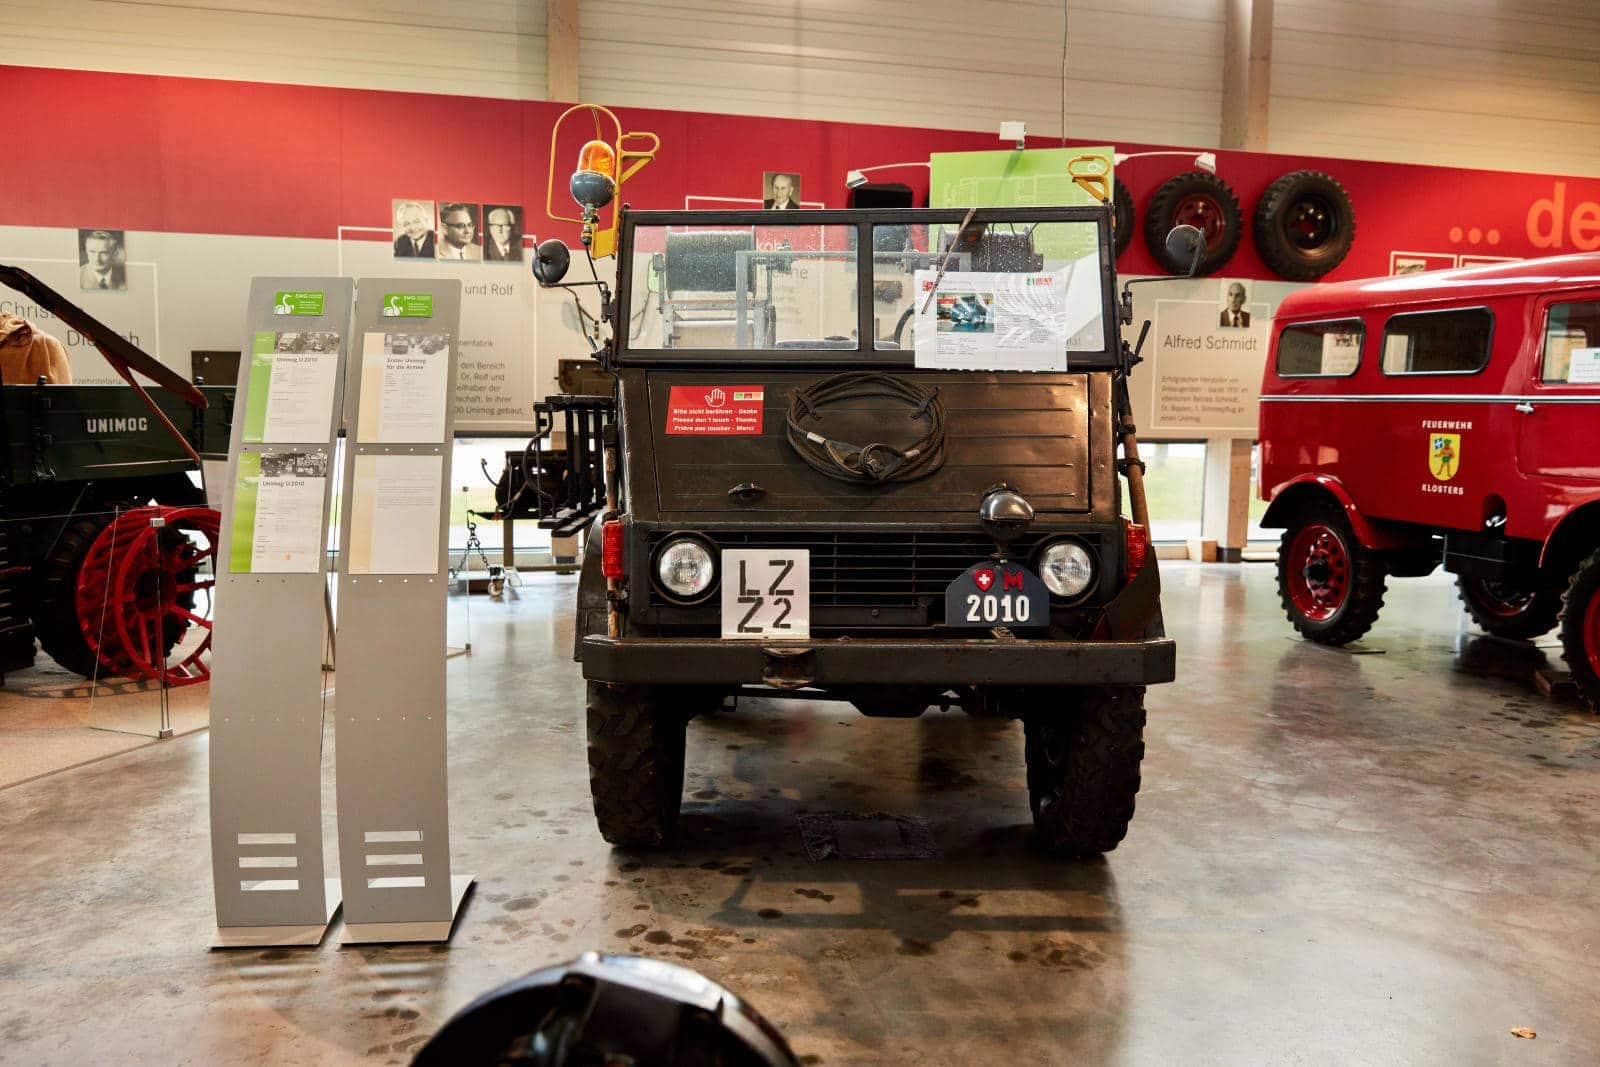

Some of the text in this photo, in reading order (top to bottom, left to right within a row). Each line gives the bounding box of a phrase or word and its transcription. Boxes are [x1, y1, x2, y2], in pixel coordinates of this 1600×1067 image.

[464, 282, 514, 296] und Rolf
[1163, 334, 1257, 351] Alfred Schmidt
[86, 416, 149, 434] UNIMOG
[1422, 420, 1473, 430] FEUERWEHR
[1421, 483, 1465, 496] KLOSTERS
[1003, 569, 1024, 592] M
[966, 594, 1030, 622] 2010
